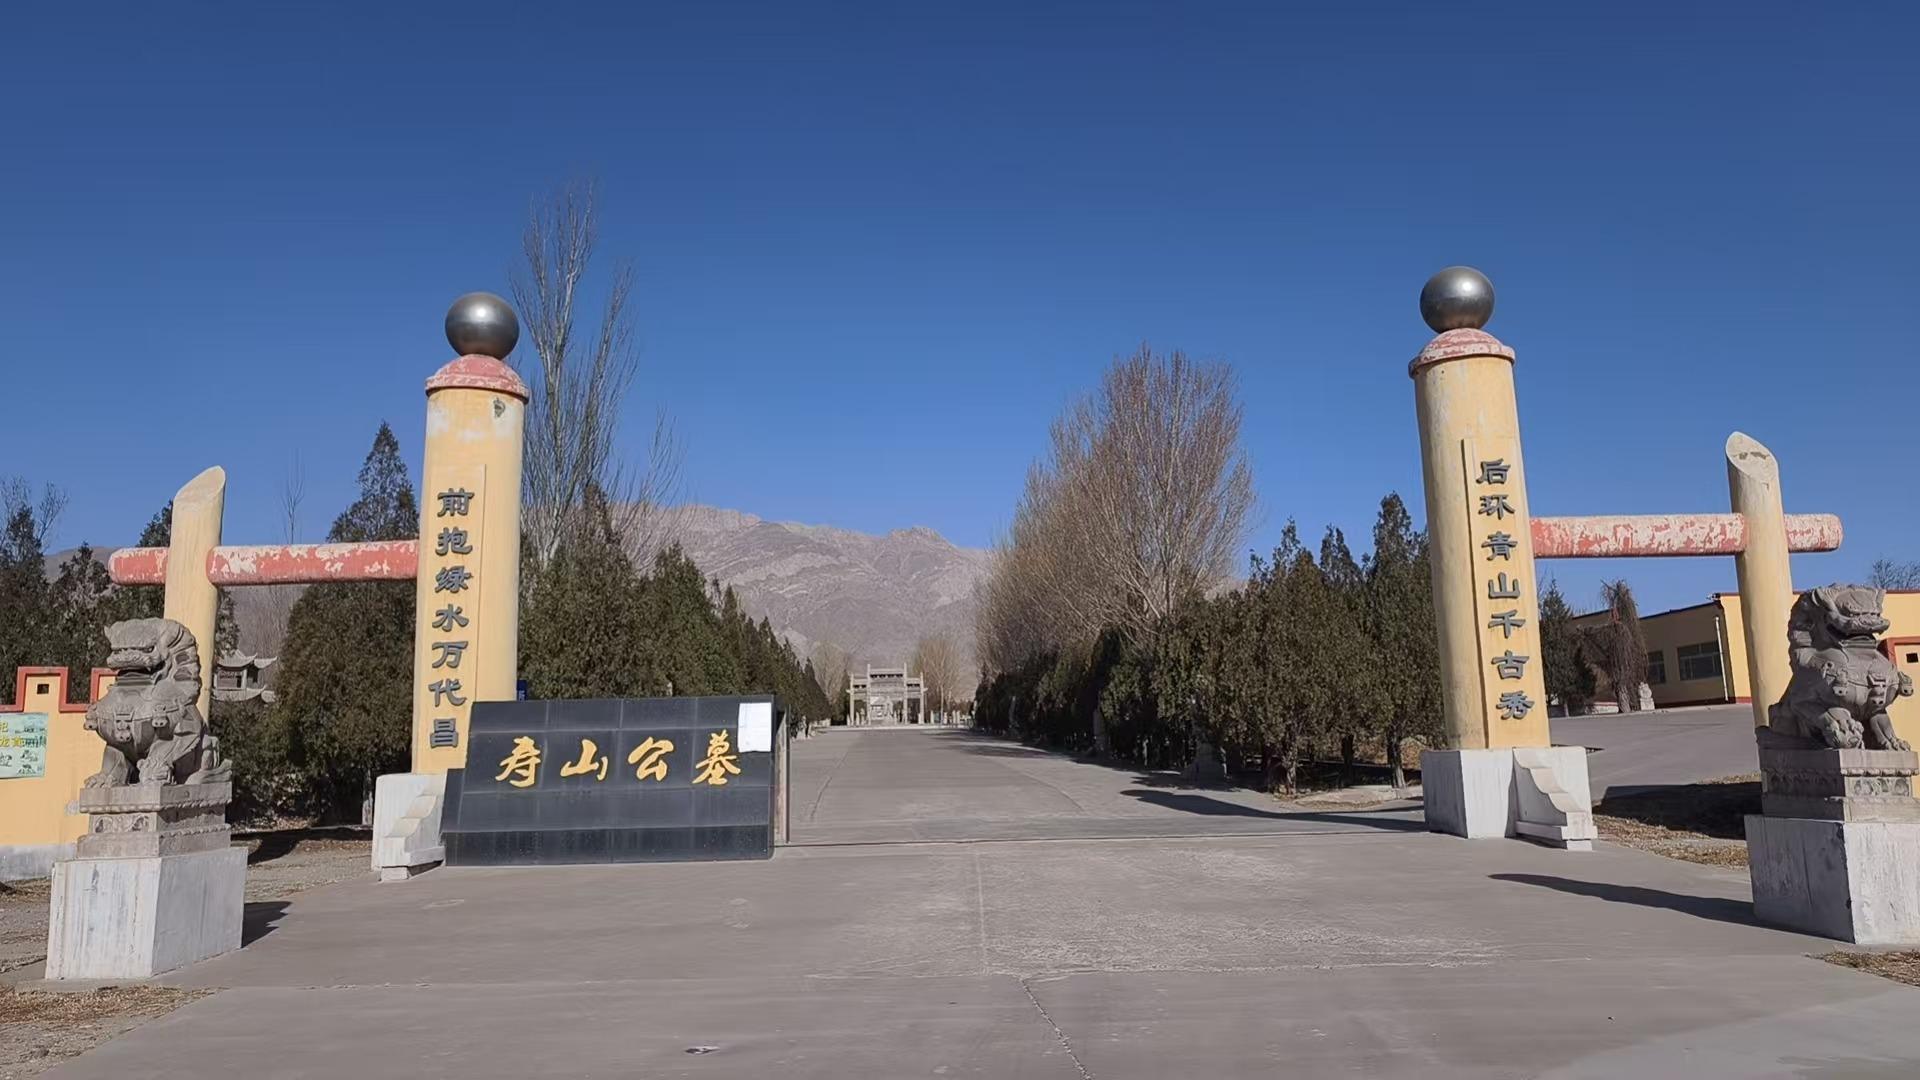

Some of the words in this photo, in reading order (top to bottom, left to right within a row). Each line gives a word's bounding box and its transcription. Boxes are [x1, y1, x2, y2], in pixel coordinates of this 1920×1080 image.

[428, 488, 474, 748] 前抱绿水万代昌
[1476, 459, 1534, 720] 后环青山千古秀
[495, 730, 741, 788] 寿山公墓
